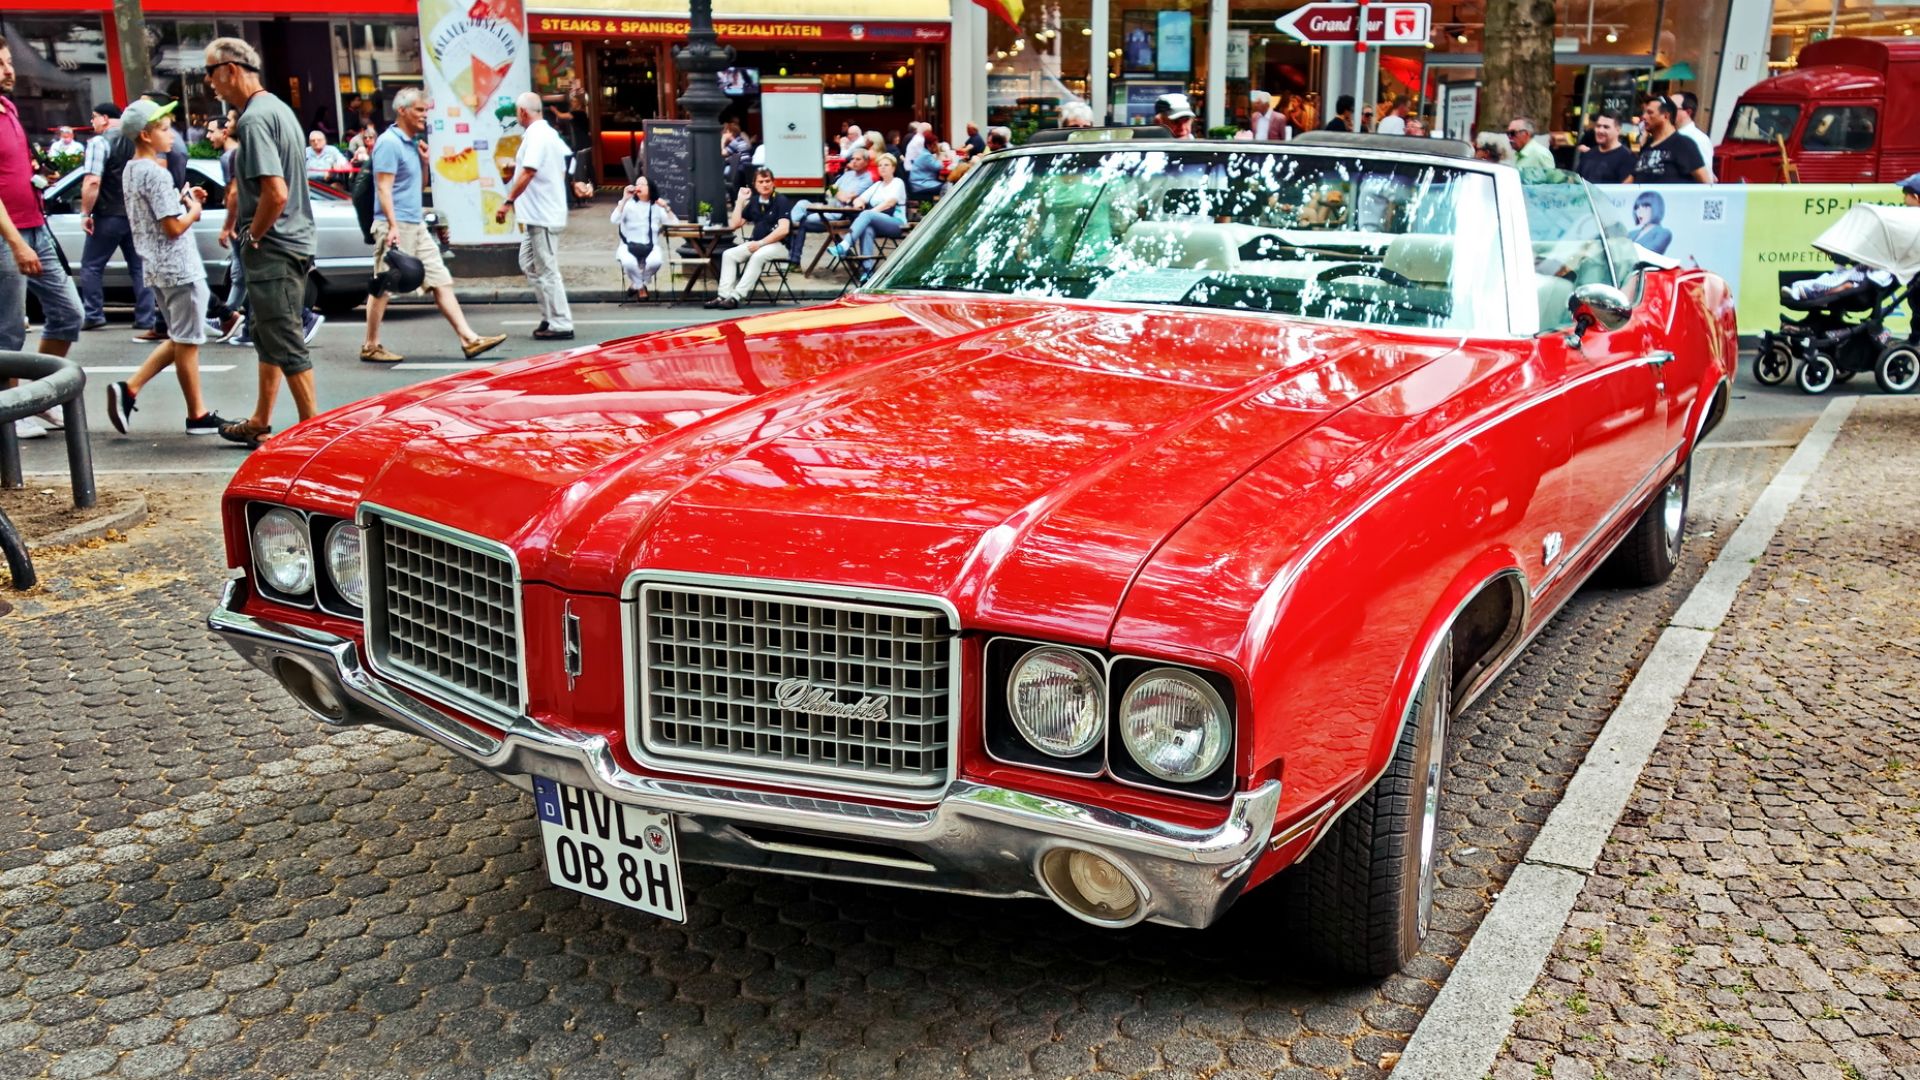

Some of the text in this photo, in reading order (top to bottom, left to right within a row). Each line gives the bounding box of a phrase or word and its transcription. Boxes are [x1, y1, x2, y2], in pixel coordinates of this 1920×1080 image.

[541, 18, 822, 37] STEAKS & SPANISCH SPEZIALITÄTEN
[1310, 15, 1384, 32] Grand Tur
[1758, 251, 1833, 263] KOMPETEN
[545, 802, 556, 817] D
[560, 784, 644, 850] HVL
[556, 834, 674, 911] OB 8H
